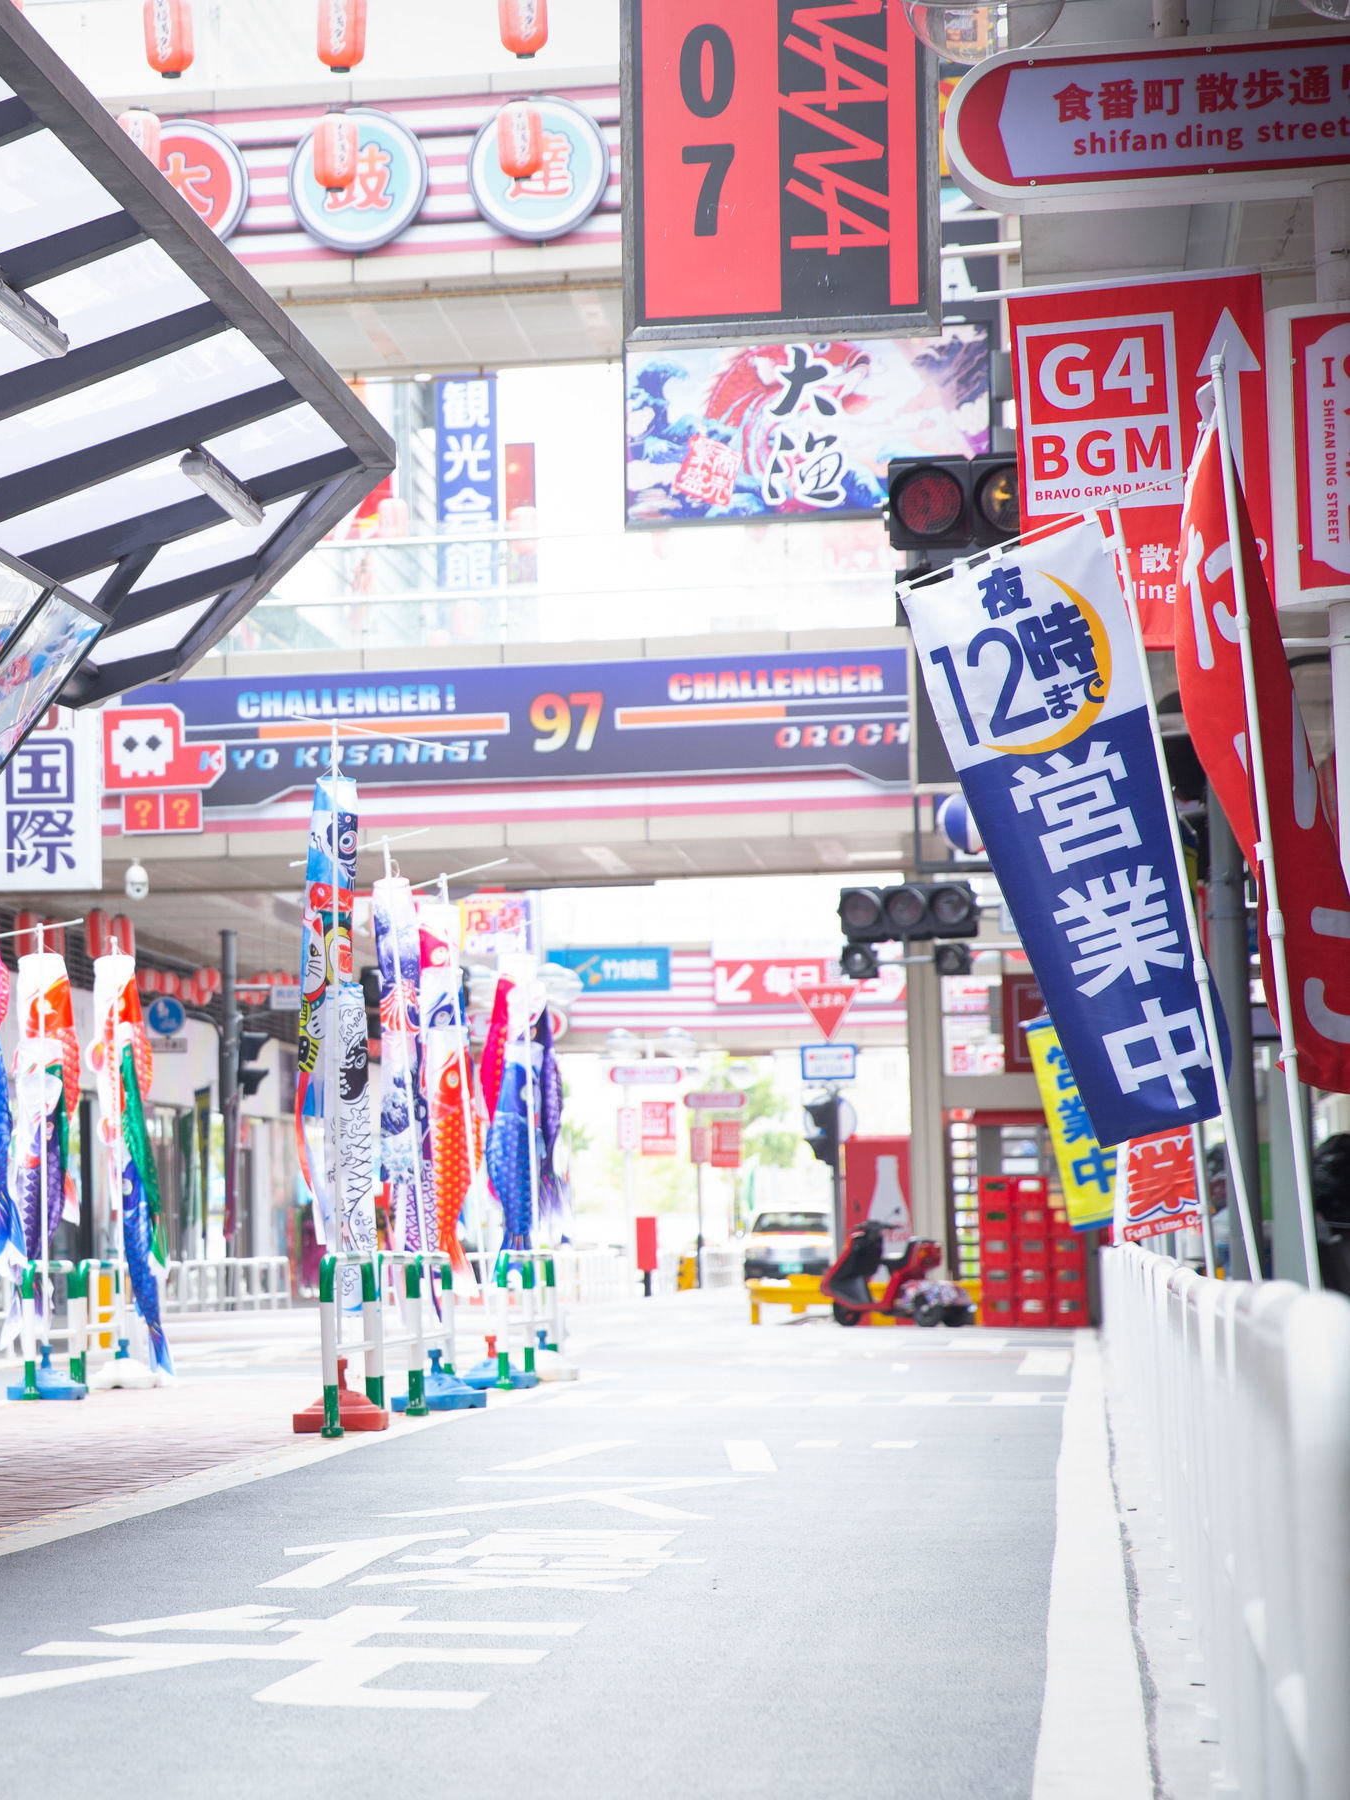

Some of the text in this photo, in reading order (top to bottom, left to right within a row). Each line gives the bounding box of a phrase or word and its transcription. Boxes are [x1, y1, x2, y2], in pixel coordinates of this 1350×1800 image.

[1053, 78, 1185, 123] 食番町
[1073, 116, 1350, 155] shifan ding street
[1039, 337, 1154, 410] G4
[1031, 425, 1172, 481] BGM
[1323, 399, 1340, 544] SHIFAN DING STREET
[1035, 481, 1172, 501] BRAVO GRAND MALL
[977, 566, 1032, 620] 夜
[668, 664, 884, 701] CHALLENGER
[529, 691, 604, 752] 97
[199, 748, 280, 771] KYO
[5, 738, 76, 875] 国際
[1010, 740, 1212, 1109] 営業中
